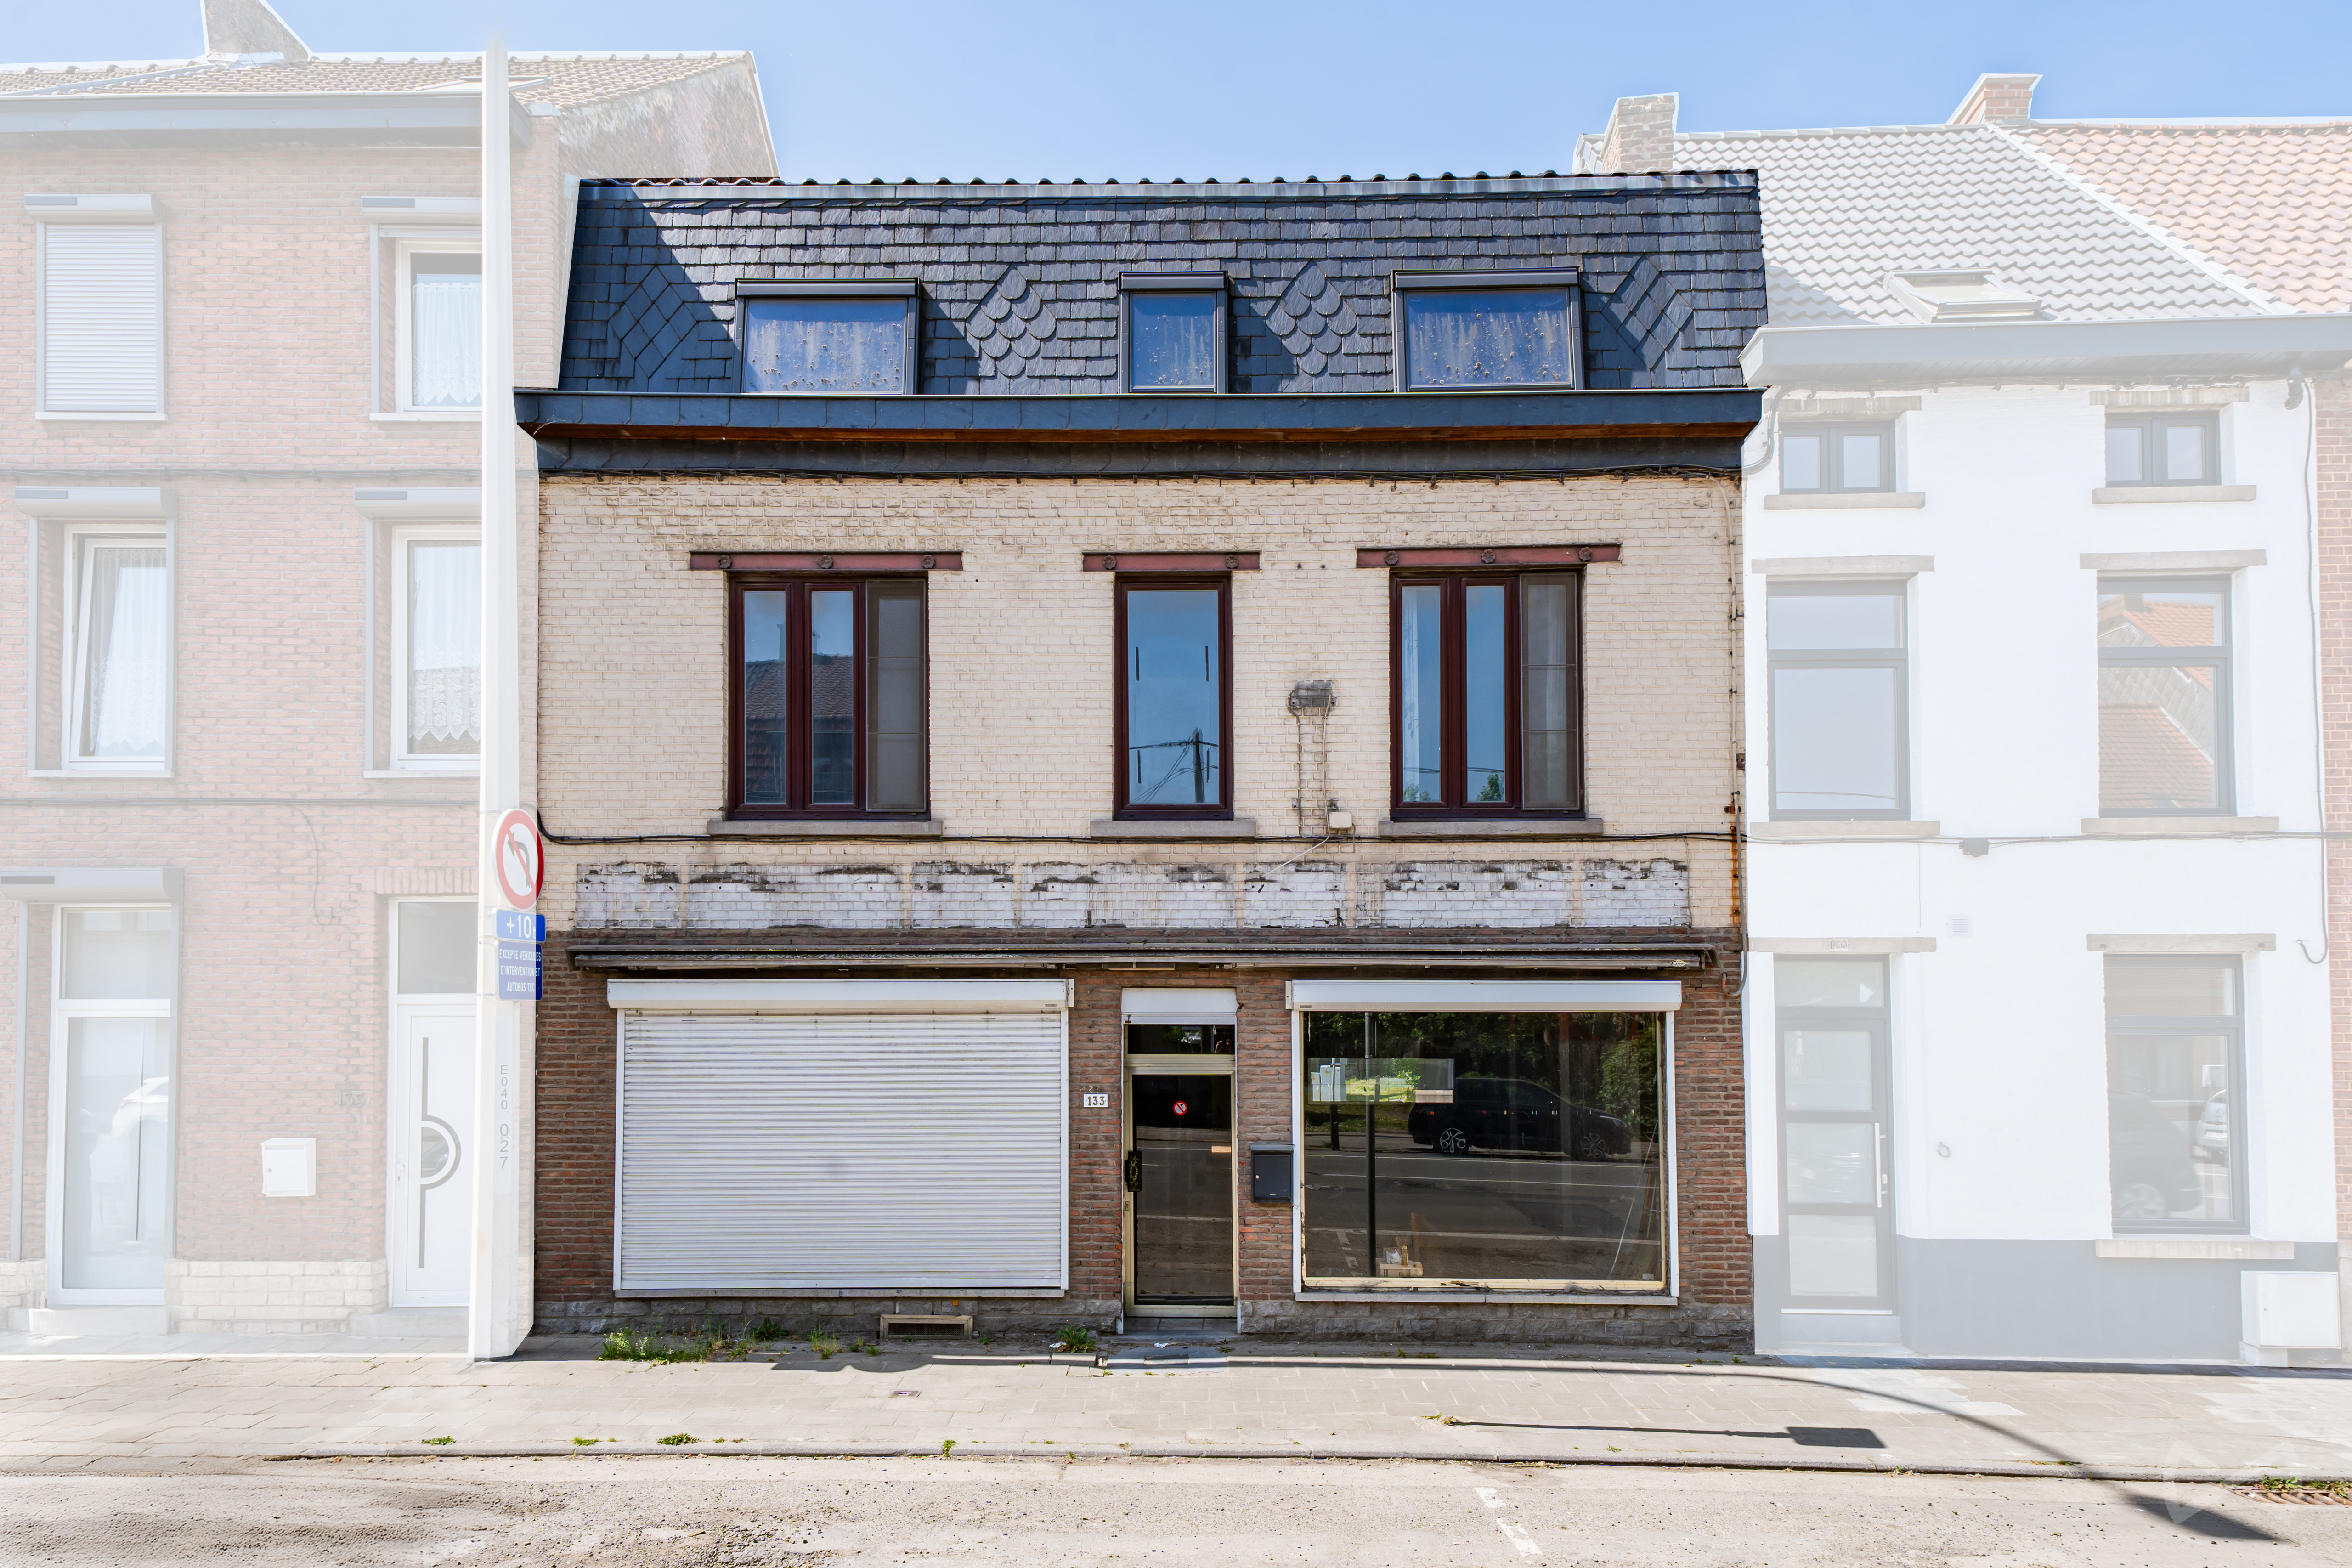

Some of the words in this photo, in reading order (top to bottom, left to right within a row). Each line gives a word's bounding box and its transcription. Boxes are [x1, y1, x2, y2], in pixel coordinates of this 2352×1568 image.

[499, 949, 518, 960] EXCEPTE
[520, 951, 541, 961] VEHICULES
[501, 965, 534, 977] D'INTERVENTION
[535, 967, 540, 977] ET
[507, 982, 526, 992] AUTOBUS
[339, 1092, 366, 1106] 135
[1088, 1096, 1105, 1106] 133
